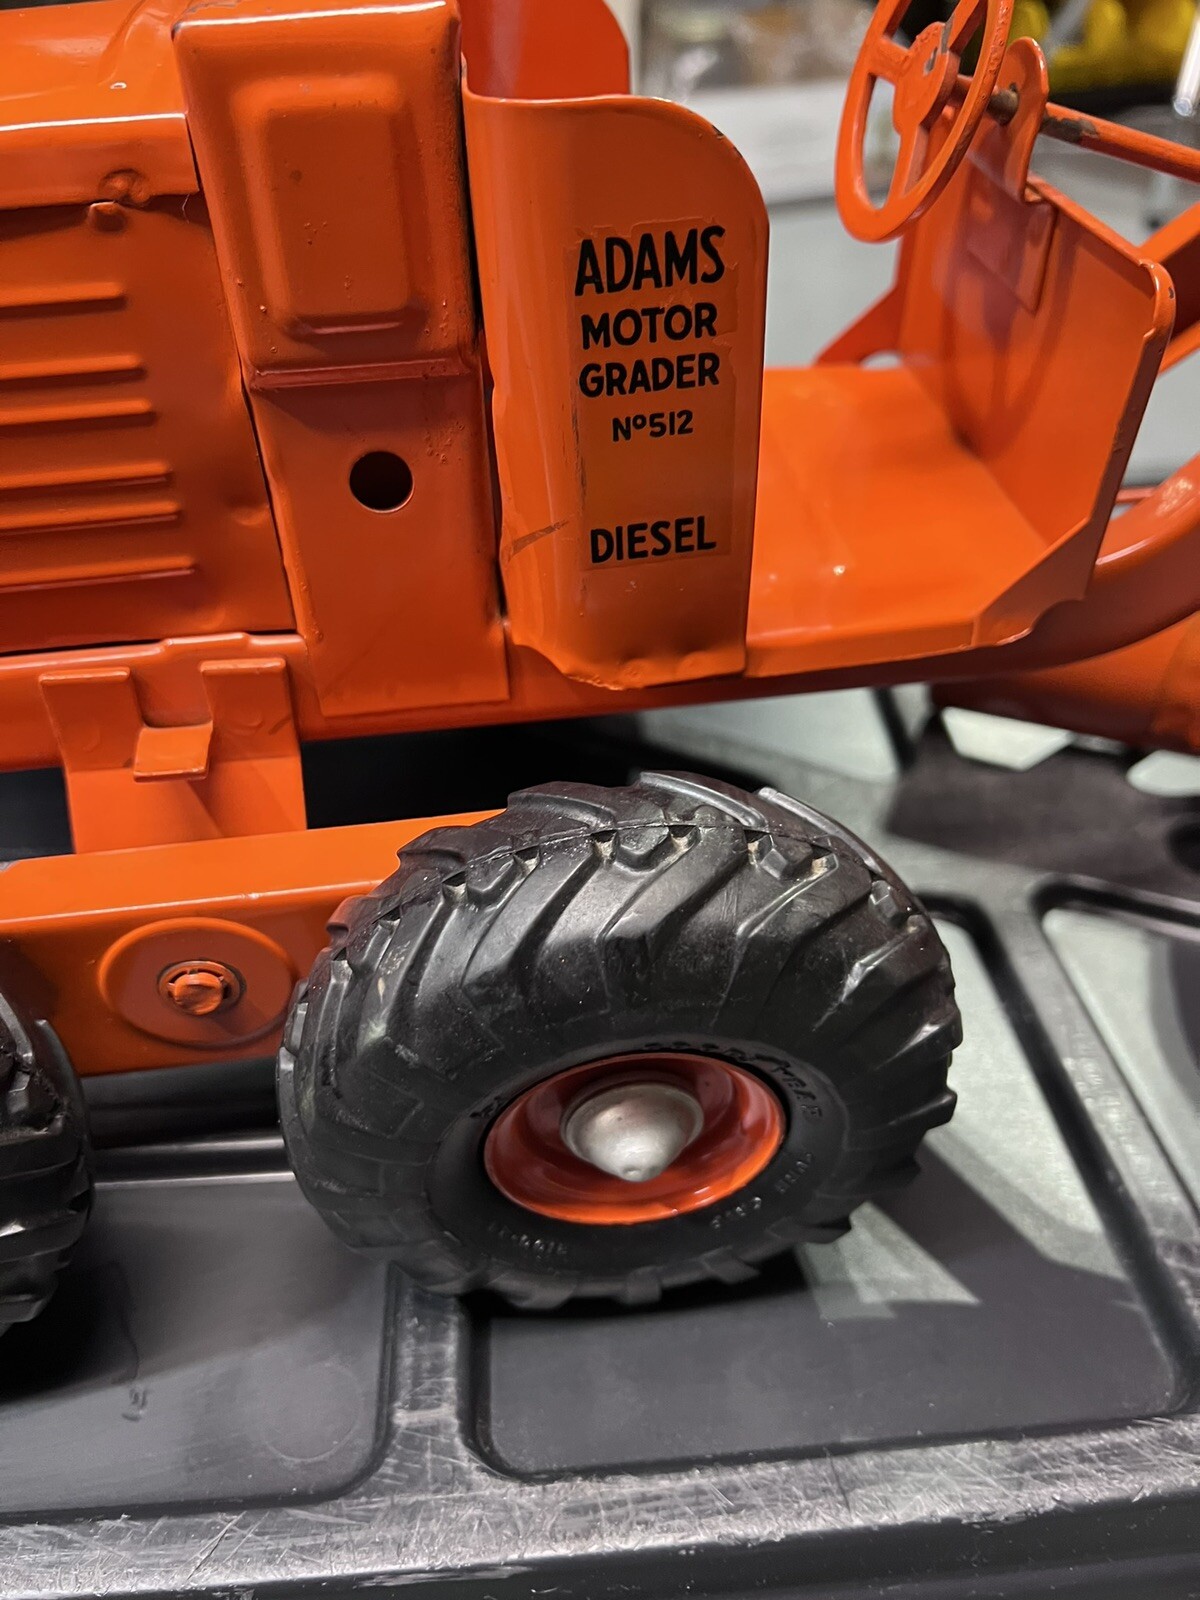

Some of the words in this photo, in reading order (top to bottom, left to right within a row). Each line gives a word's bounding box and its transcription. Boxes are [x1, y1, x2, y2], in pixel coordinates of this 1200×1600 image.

[575, 225, 726, 296] ADAMS
[581, 302, 718, 350] MOTOR
[579, 352, 721, 398] GRADER
[590, 515, 717, 564] DIESEL
